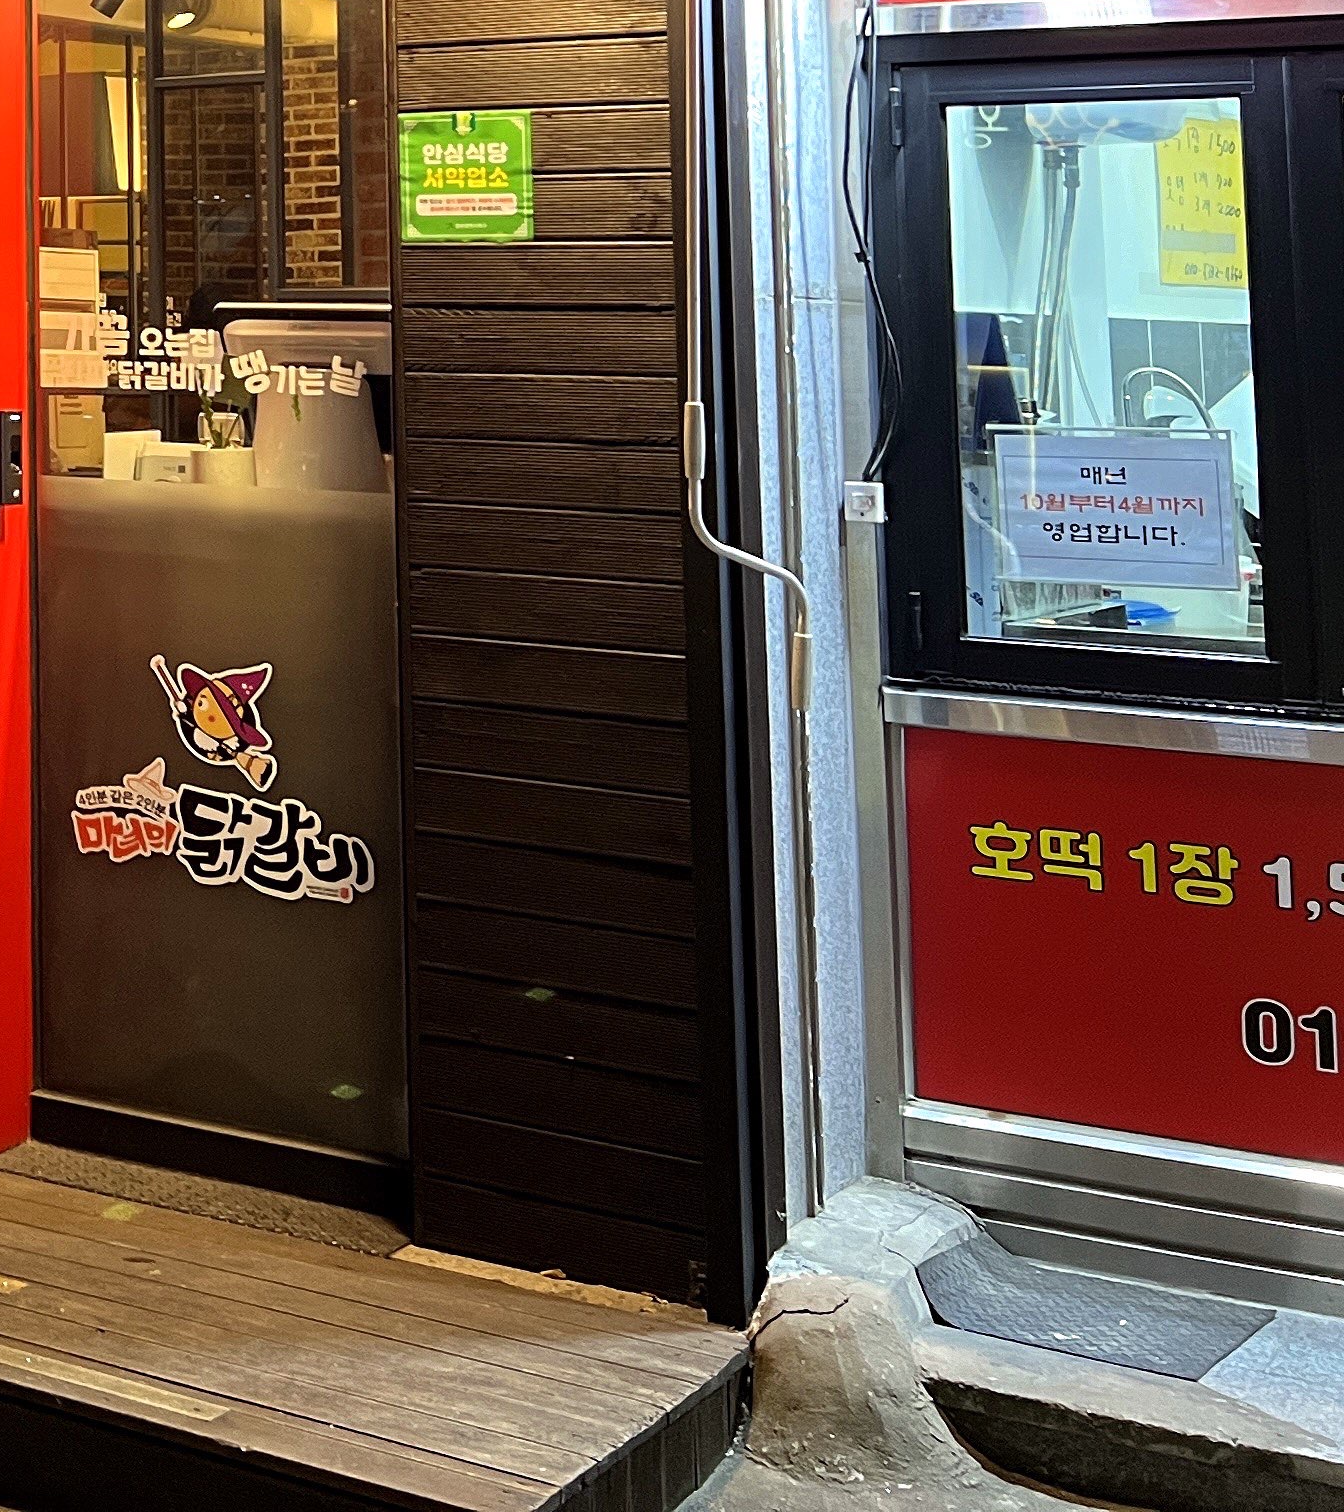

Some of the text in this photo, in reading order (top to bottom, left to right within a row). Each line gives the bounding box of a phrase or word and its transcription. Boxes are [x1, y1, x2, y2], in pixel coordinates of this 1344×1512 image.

[422, 142, 509, 165] 안심식당
[423, 167, 509, 188] 서약업소
[1080, 465, 1128, 486] 매년
[1042, 521, 1187, 547] 영업합니다.
[78, 790, 108, 805] 4인분
[74, 787, 371, 895] 마녀의 닭갈비
[970, 821, 1105, 892] 호떡
[1129, 841, 1239, 907] 1장
[1241, 998, 1341, 1074] 01
